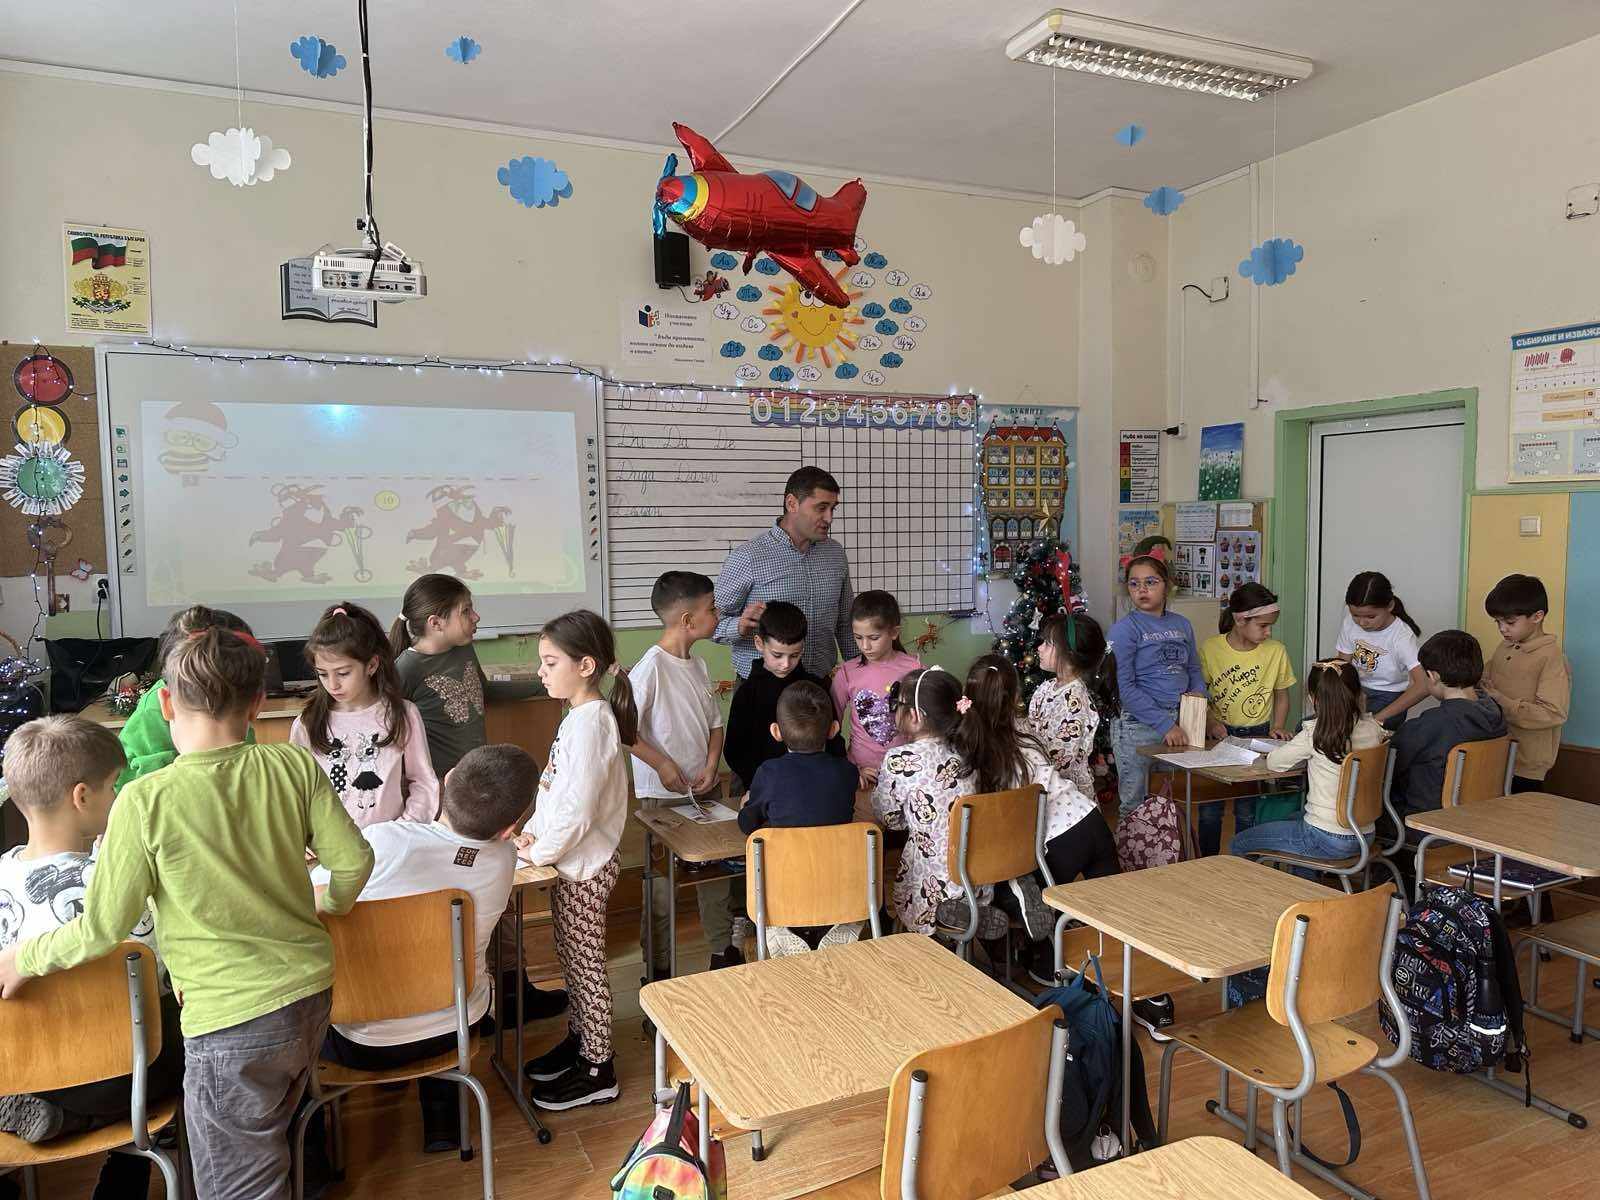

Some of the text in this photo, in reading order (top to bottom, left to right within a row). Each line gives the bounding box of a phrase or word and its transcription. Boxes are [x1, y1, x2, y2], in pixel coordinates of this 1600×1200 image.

[1516, 333, 1557, 347] СЪБИРАНЕ
[753, 396, 972, 426] 0 1 2 3 4 5 6 7 8 9
